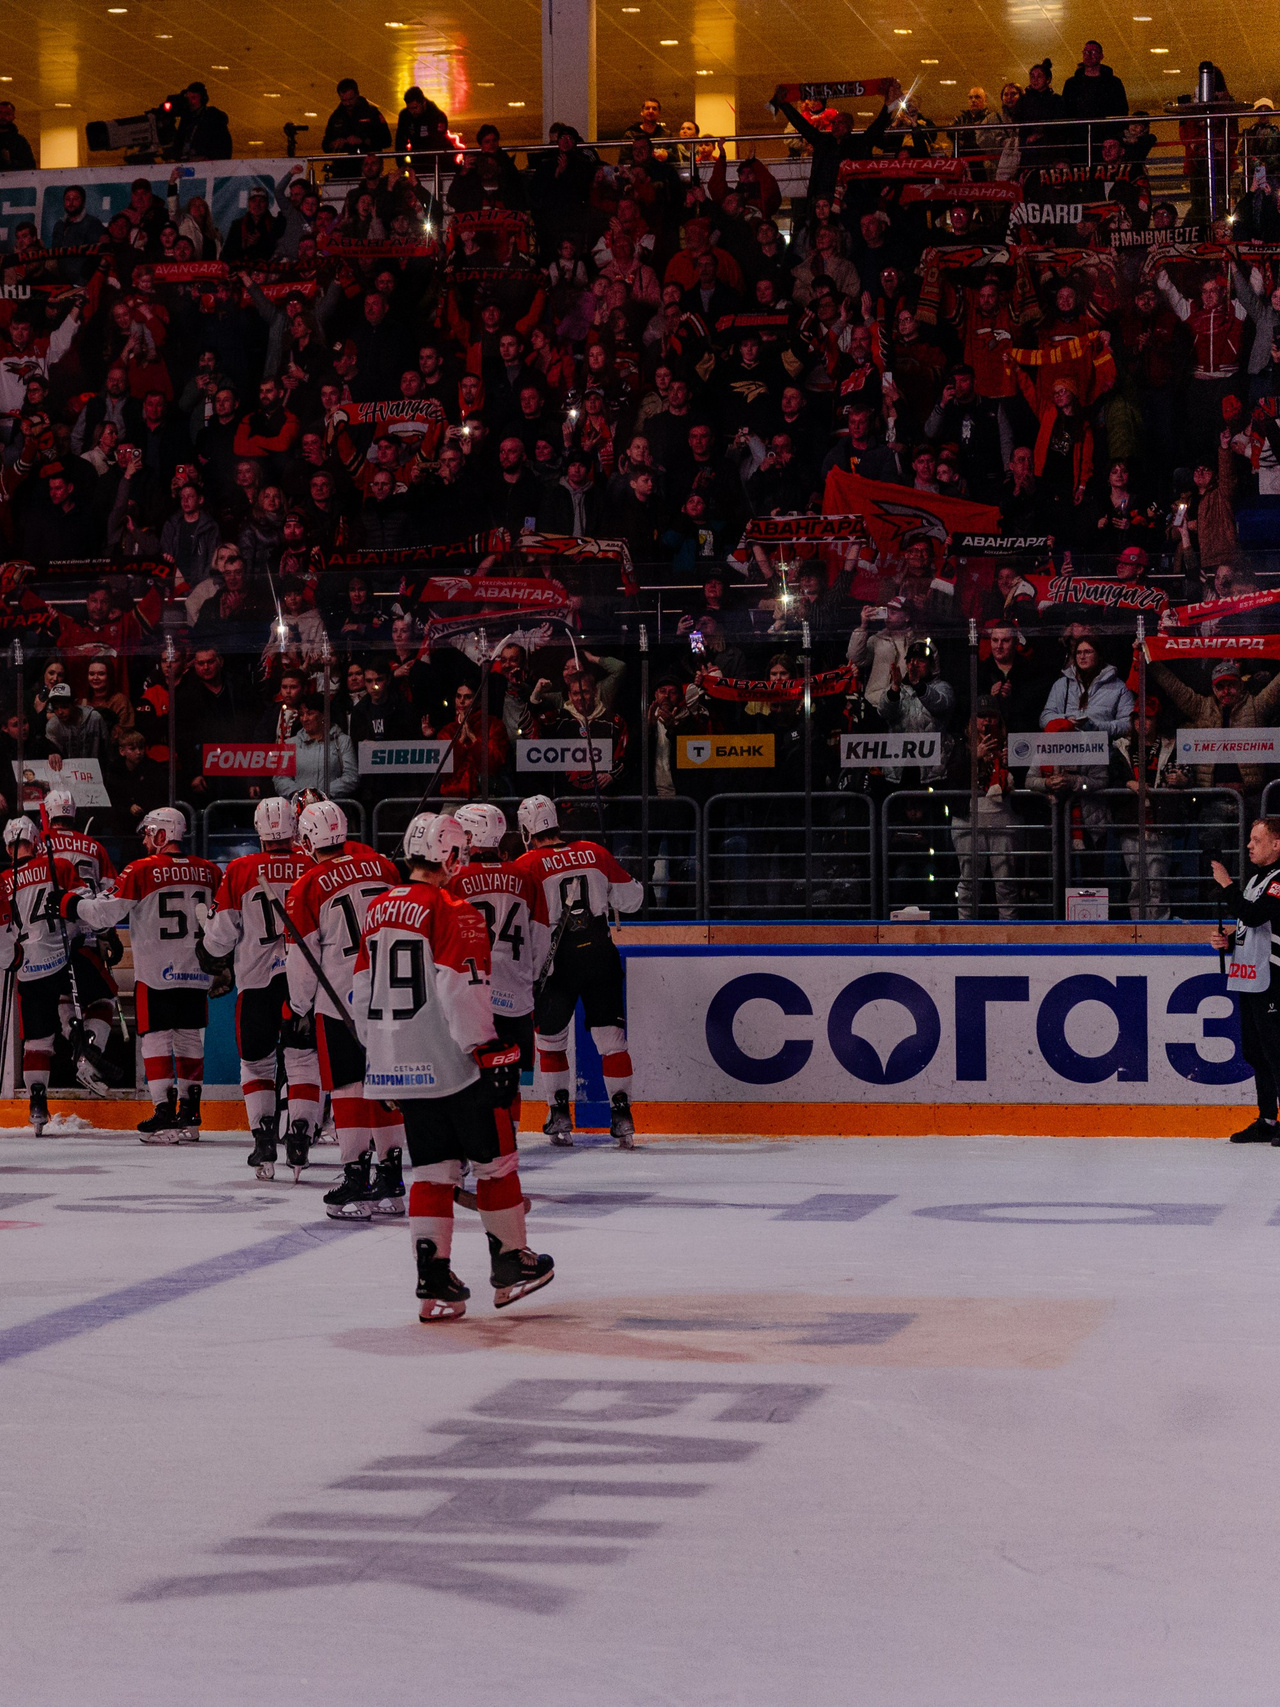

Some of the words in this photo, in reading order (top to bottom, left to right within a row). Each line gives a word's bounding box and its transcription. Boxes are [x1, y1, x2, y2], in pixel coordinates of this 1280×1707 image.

[867, 157, 959, 172] АВАНГАРД
[1038, 163, 1132, 188] АВАНГАРД
[947, 187, 1017, 198] АВАНГАР
[1110, 226, 1200, 248] #МЫВМЕСТЕ
[750, 519, 866, 536] АВАНГАРД
[962, 536, 1048, 548] АВАНГАРД
[474, 587, 563, 605] АВАНГАРД
[1165, 638, 1266, 650] АВАНГАРД
[716, 745, 764, 757] БАНК
[846, 741, 936, 759] KHL.RU
[1036, 743, 1105, 754] ГАЗПРОМБАНК
[1194, 742, 1274, 752] T.ME/KRSCHINA
[205, 750, 295, 769] FONBET
[371, 748, 440, 765] SIBUR
[541, 849, 597, 873] MCLEOD
[152, 866, 214, 883] SPOONER
[257, 863, 305, 879] FIORE
[318, 861, 383, 892] OKULOV
[462, 873, 523, 895] GULYAYEV
[158, 891, 207, 940] 51
[367, 939, 427, 1020] 19
[394, 1065, 415, 1073] СЕТЬ
